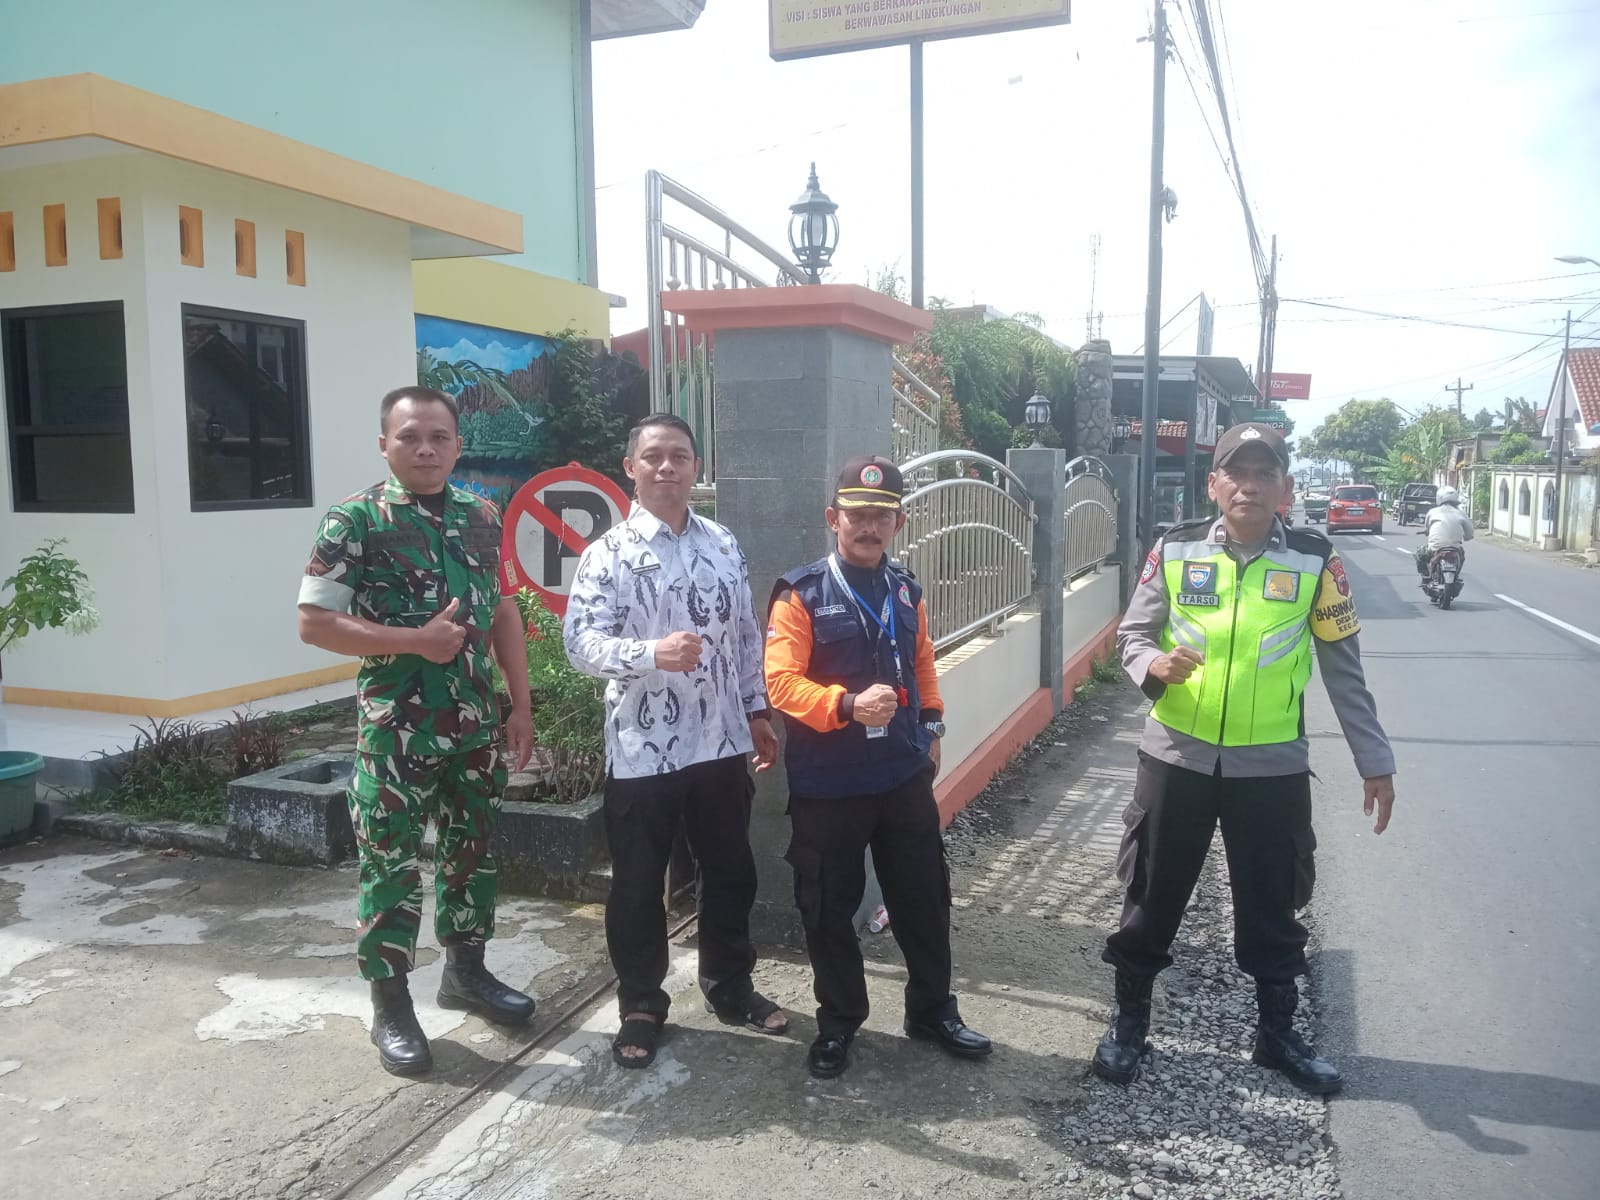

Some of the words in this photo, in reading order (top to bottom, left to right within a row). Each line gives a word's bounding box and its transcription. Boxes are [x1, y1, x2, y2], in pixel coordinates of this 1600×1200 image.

[786, 11, 805, 23] VISI
[812, 6, 842, 20] SISWA
[845, 2, 871, 15] YANG
[844, 11, 913, 30] BERWAWASAN
[915, 2, 982, 20] LINGKUNGAN
[543, 490, 612, 587] P
[1181, 595, 1215, 605] TARSO
